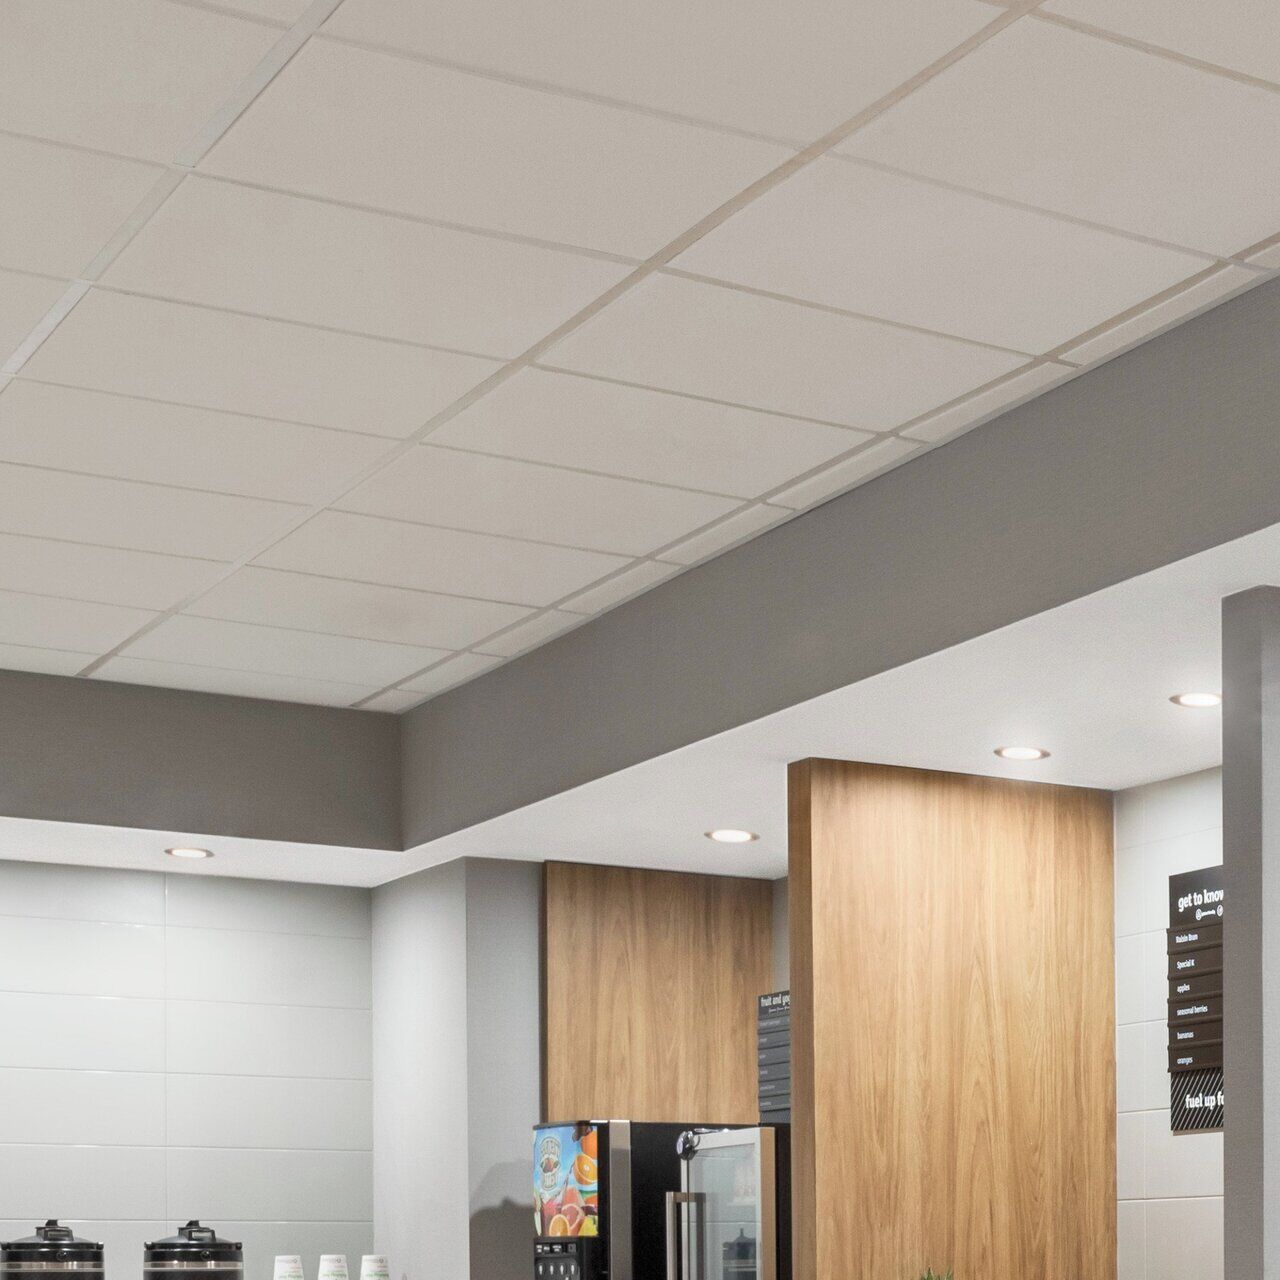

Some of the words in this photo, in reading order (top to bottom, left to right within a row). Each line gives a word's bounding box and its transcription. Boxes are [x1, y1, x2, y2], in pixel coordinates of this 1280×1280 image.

[1178, 893, 1193, 912] get
[1193, 892, 1203, 906] to
[1186, 1092, 1203, 1109] fuel
[1204, 1095, 1216, 1110] up
